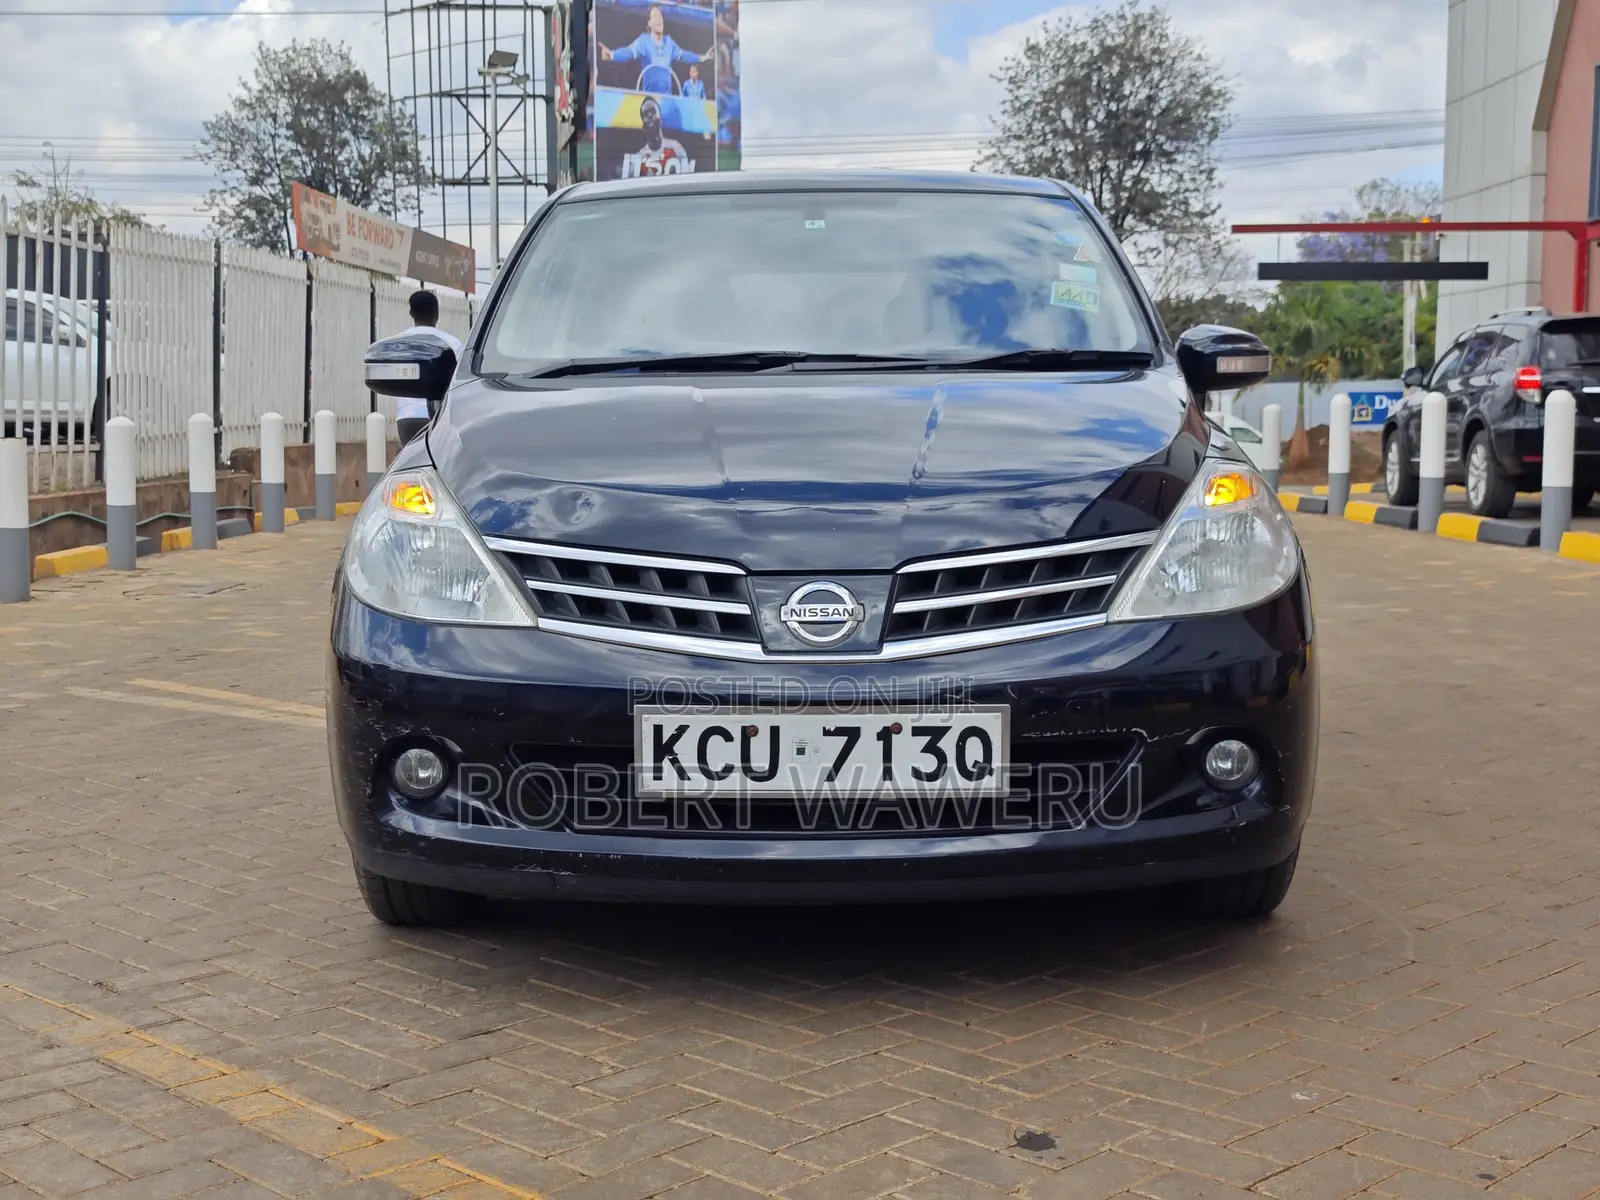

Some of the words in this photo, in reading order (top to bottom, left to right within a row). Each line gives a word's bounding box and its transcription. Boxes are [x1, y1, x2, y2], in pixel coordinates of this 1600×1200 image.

[347, 211, 356, 237] BE
[358, 215, 394, 249] FORWARD
[790, 607, 854, 618] NISSAN
[652, 724, 780, 782] KCU
[822, 725, 995, 782] 713Q
